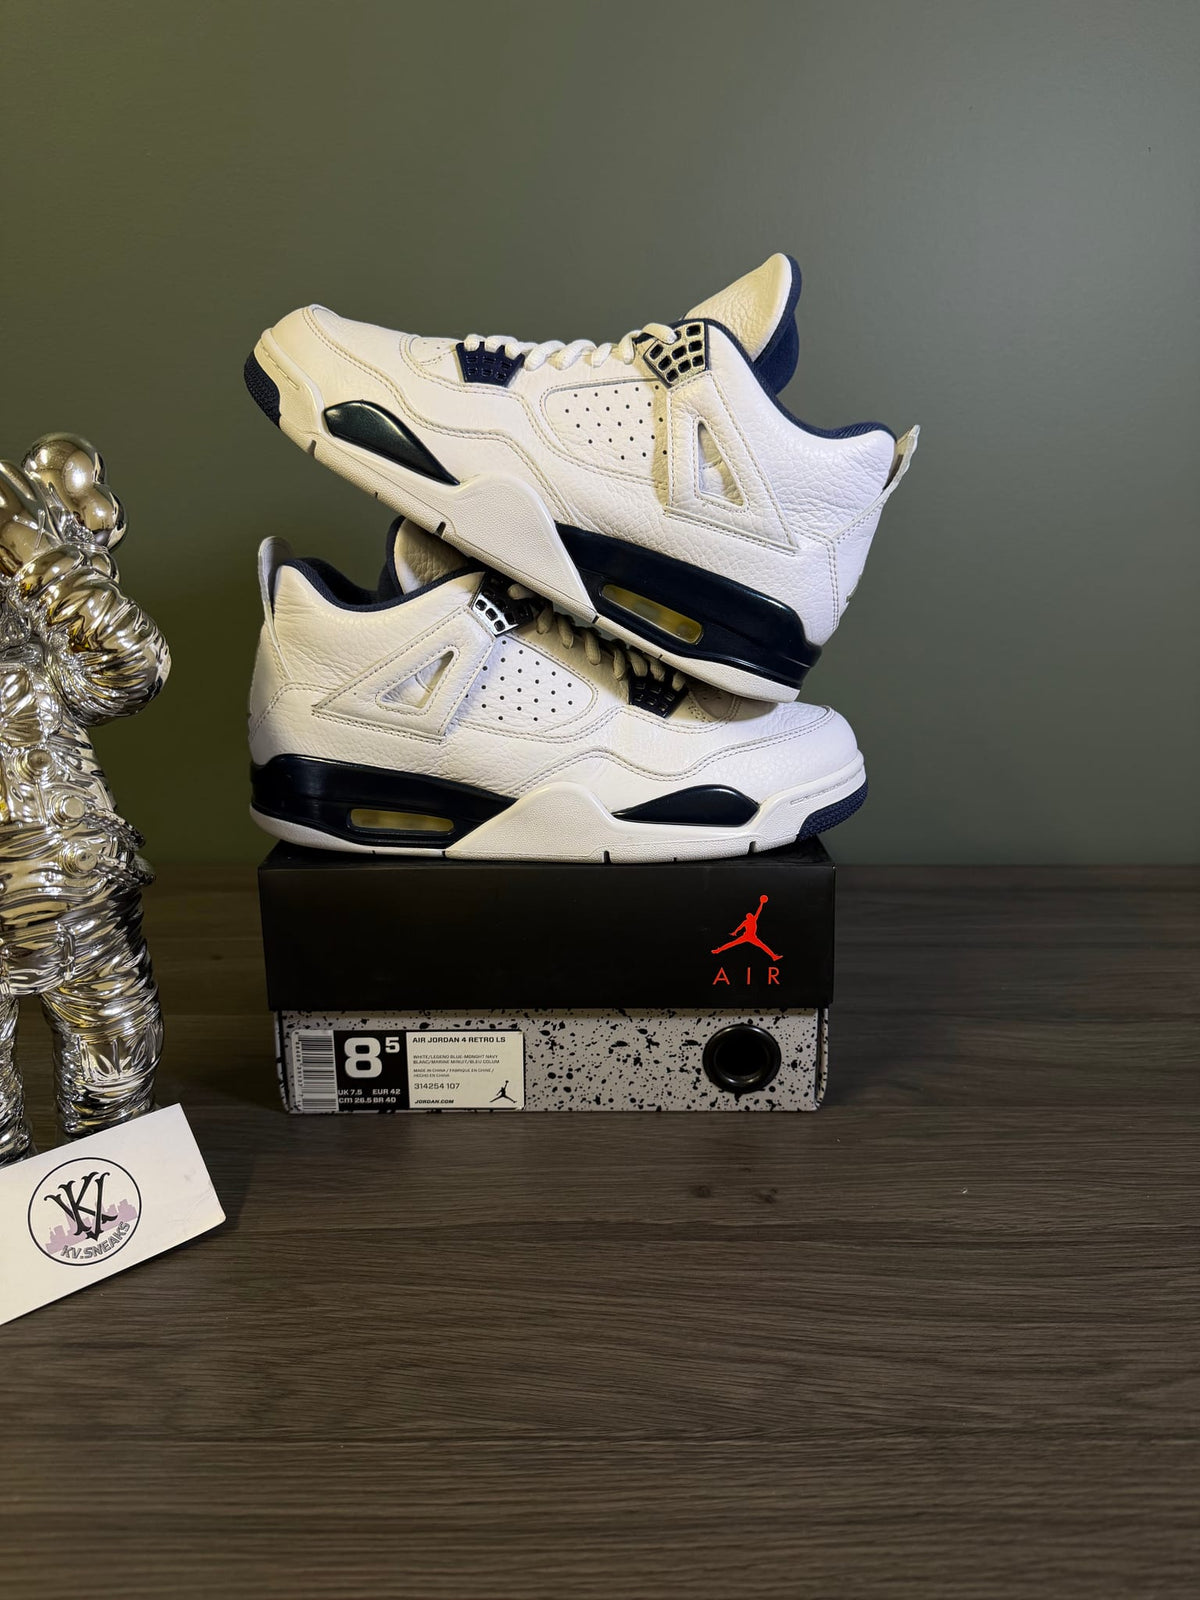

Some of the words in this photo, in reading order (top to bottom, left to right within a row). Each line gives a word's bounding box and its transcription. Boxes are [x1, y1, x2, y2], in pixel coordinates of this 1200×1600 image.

[712, 966, 780, 985] AIR
[344, 1037, 383, 1078] 8
[385, 1036, 400, 1053] 5
[414, 1082, 445, 1090] 314254
[60, 1221, 131, 1260] KV.SNEAKS
